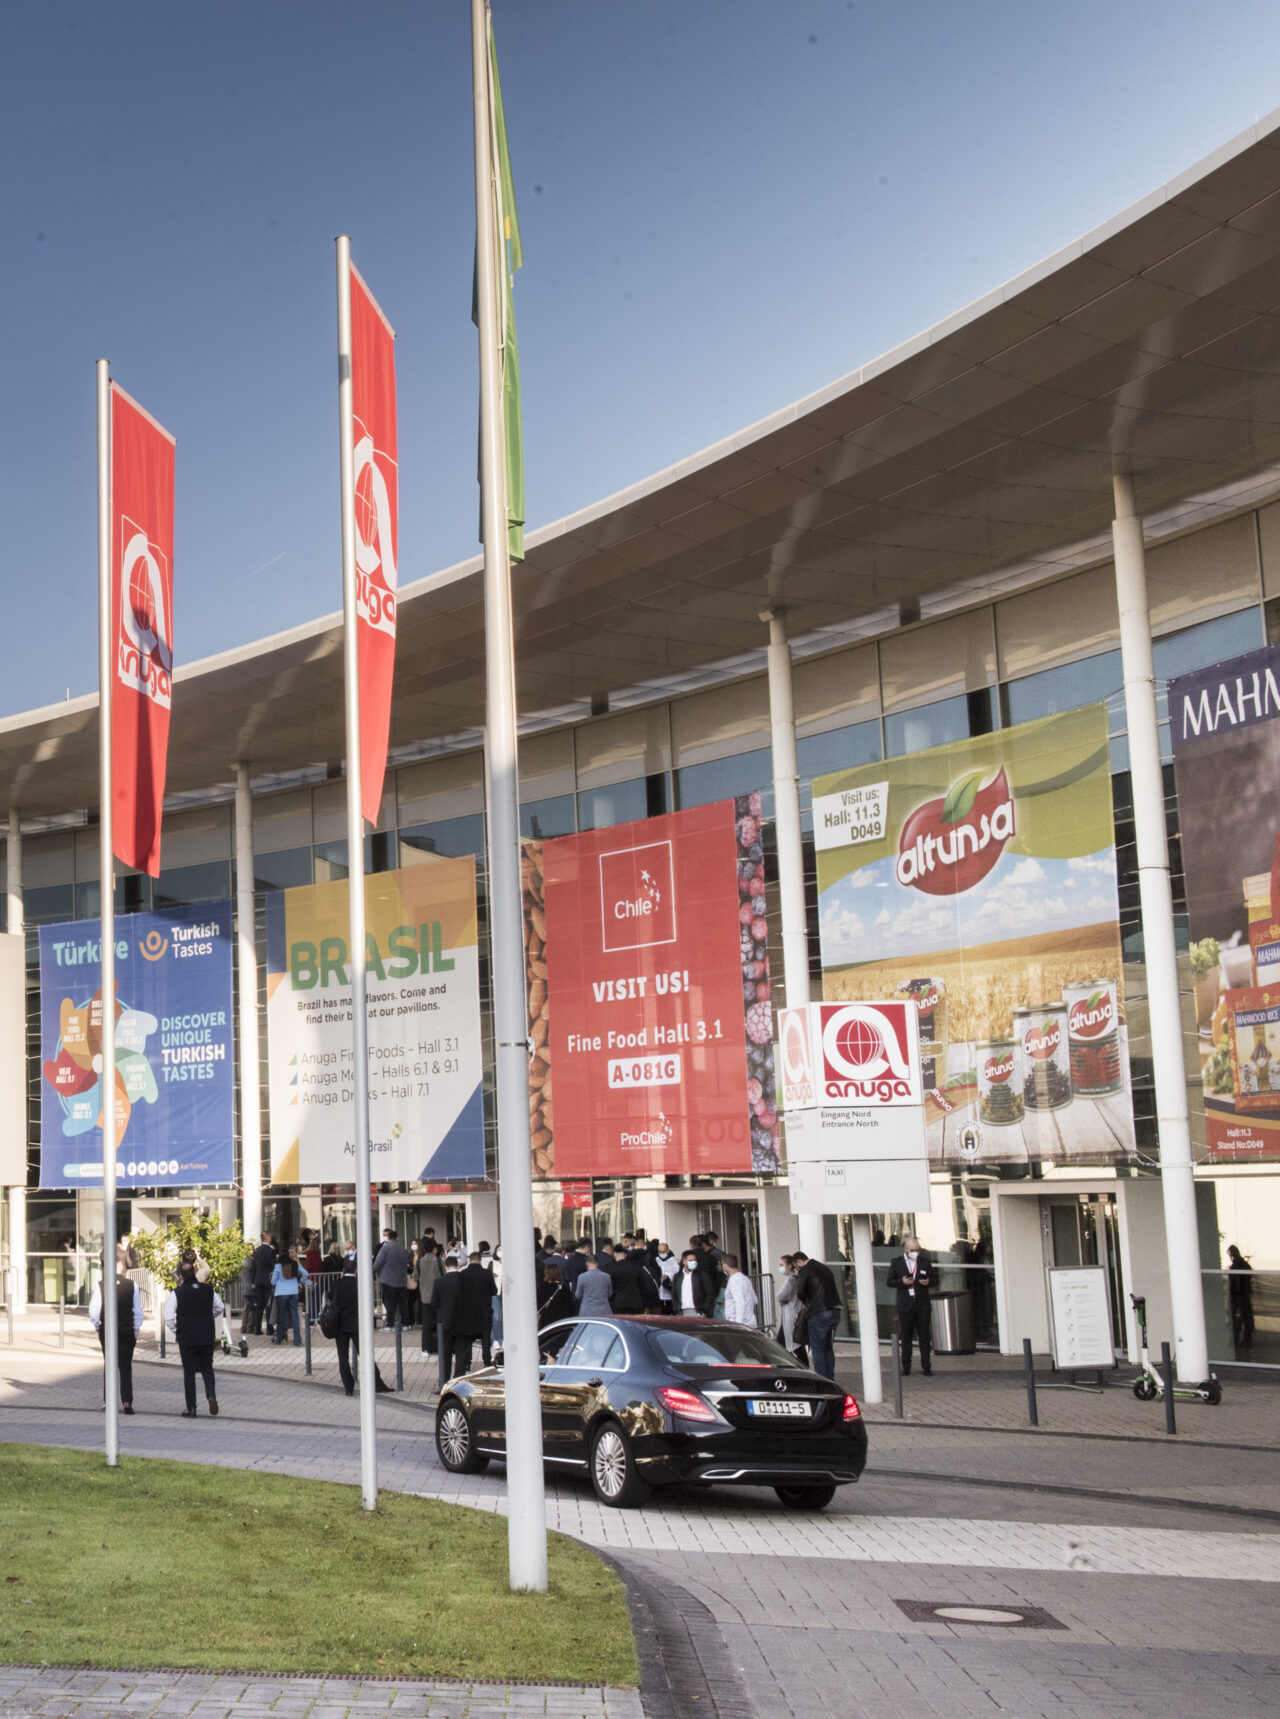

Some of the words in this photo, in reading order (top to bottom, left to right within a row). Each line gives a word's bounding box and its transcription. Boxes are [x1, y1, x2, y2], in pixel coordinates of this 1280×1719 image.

[841, 791, 863, 806] Visit
[865, 789, 880, 800] us:
[824, 811, 852, 828] Hall:
[855, 803, 881, 820] 11.3
[851, 822, 882, 841] D049
[897, 800, 1014, 884] altunsa
[614, 898, 653, 919] Chile
[171, 922, 220, 942] Turkish
[172, 942, 213, 959] Tastes
[593, 977, 648, 1003] VISIT
[655, 970, 690, 996] US!
[297, 999, 321, 1011] Brazil
[323, 997, 338, 1009] has
[340, 997, 352, 1007] ma
[400, 988, 427, 1000] Come
[429, 984, 447, 996] and
[161, 1011, 226, 1032] DISCOVER
[306, 1013, 323, 1025] find
[325, 1011, 345, 1022] their
[368, 1008, 377, 1018] at
[379, 1008, 394, 1017] our
[397, 1001, 440, 1017] pavilions.
[1069, 1001, 1113, 1033] altunsa
[161, 1029, 212, 1048] UNIQUE
[567, 1033, 602, 1053] Fine
[608, 1027, 647, 1050] Food
[654, 1022, 690, 1045] Hall
[696, 1019, 723, 1041] 3.1
[1024, 1030, 1061, 1055] altunsa
[161, 1045, 225, 1064] TURKISH
[301, 1051, 337, 1067] Anuga
[368, 1044, 405, 1060] Foods
[418, 1039, 440, 1055] Hall
[444, 1037, 459, 1053] 3.1
[162, 1064, 214, 1083] TASTES
[301, 1072, 338, 1087] Anuga
[382, 1064, 410, 1079] Halls
[413, 1061, 429, 1076] 6.1
[431, 1060, 441, 1074] &
[444, 1058, 459, 1073] 9.1
[612, 1059, 676, 1084] A-081G
[983, 1058, 1015, 1079] altunsa
[302, 1092, 338, 1107] Anuga
[391, 1084, 413, 1099] Hall
[416, 1082, 430, 1097] 7.1
[785, 1085, 812, 1105] anuga
[825, 1080, 912, 1102] anuga
[821, 1111, 850, 1119] Eingang
[851, 1110, 872, 1118] Nord
[821, 1120, 855, 1128] Entrance
[856, 1120, 879, 1128] North
[620, 1131, 668, 1145] ProChile
[1217, 1141, 1235, 1149] Stand
[826, 1169, 844, 1177] TAXI
